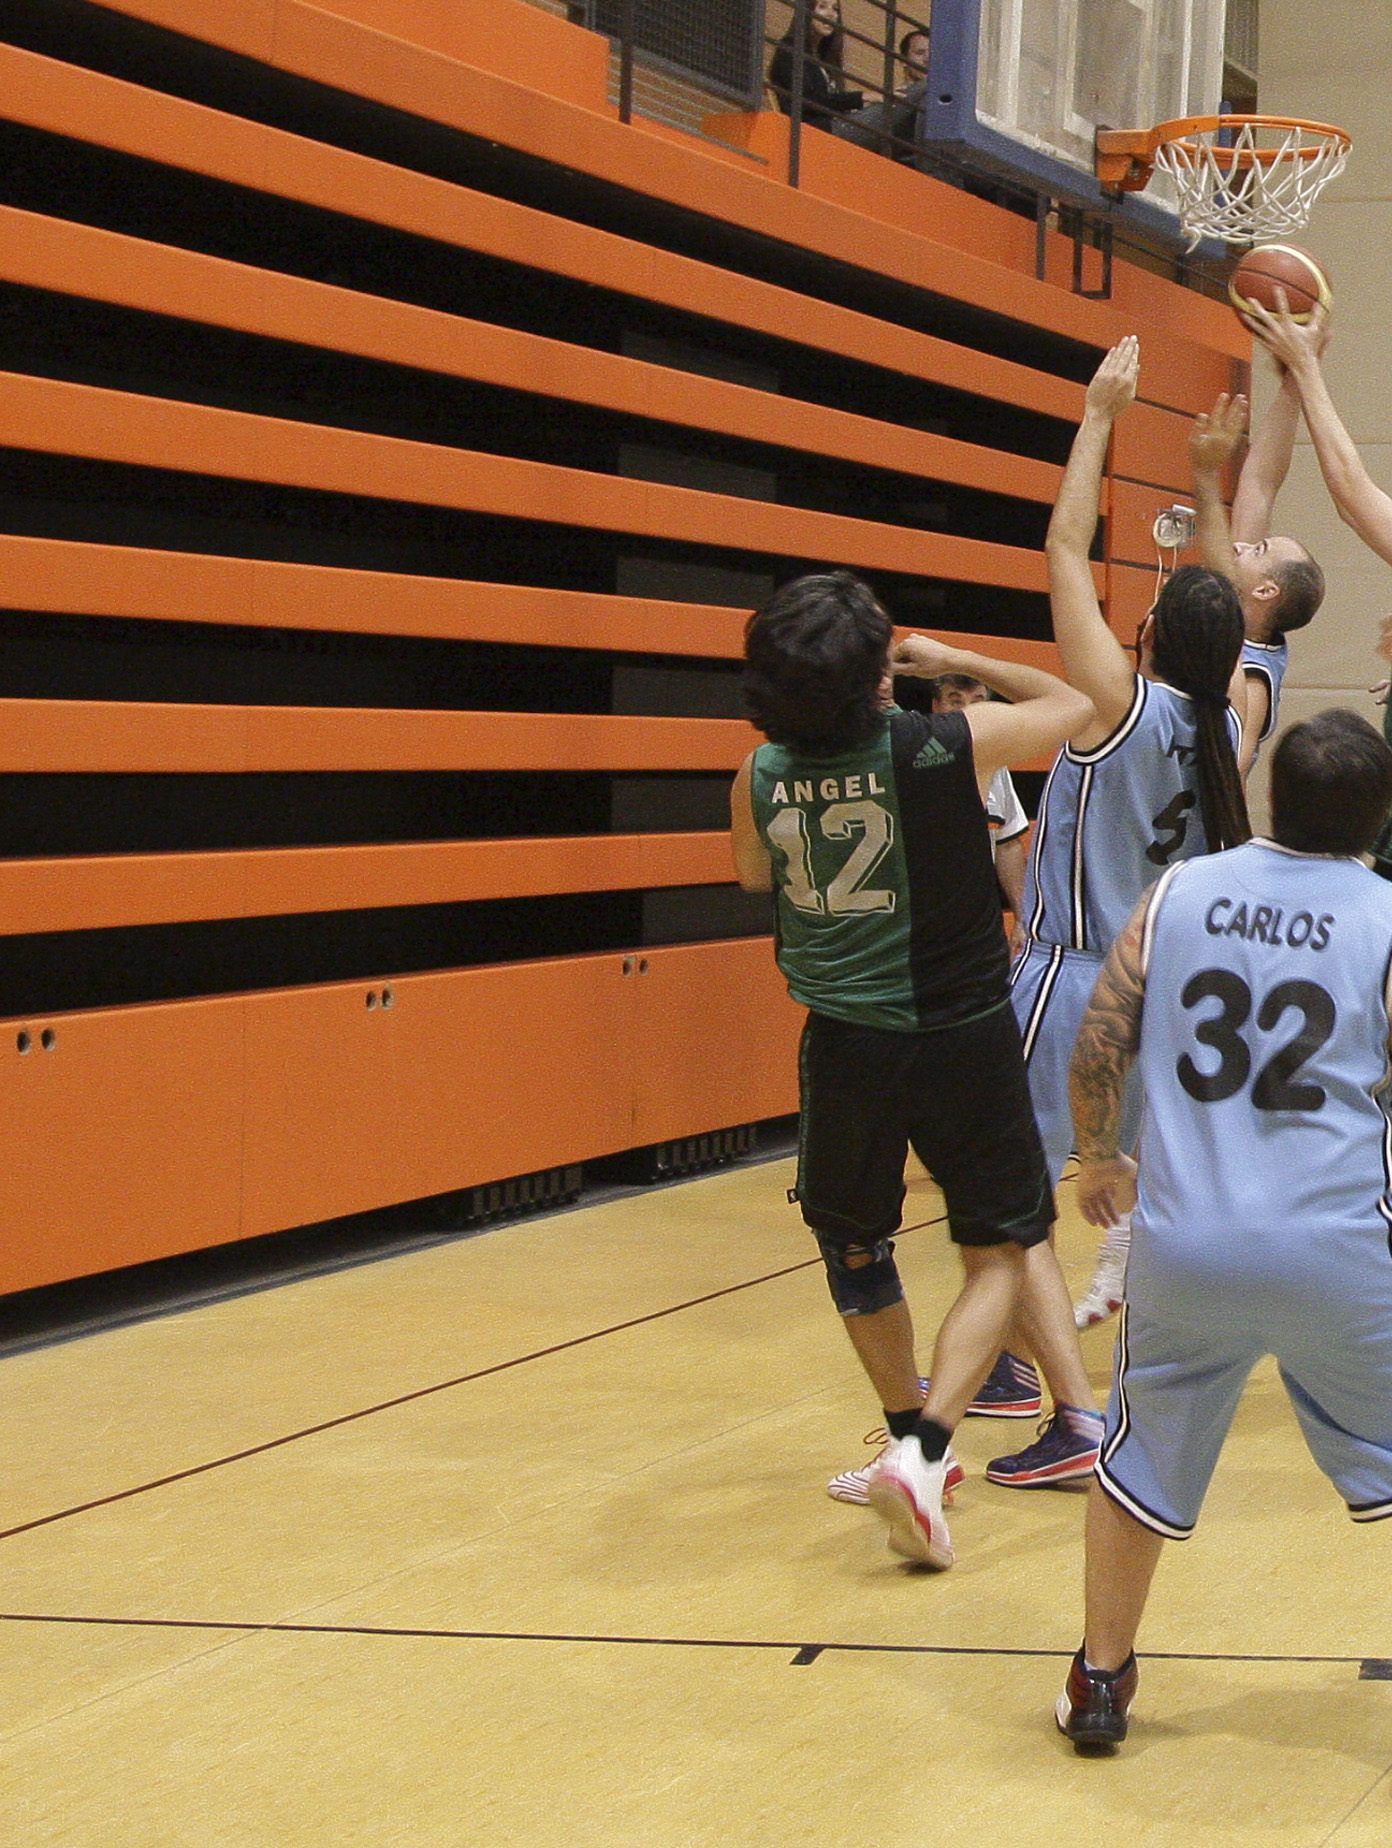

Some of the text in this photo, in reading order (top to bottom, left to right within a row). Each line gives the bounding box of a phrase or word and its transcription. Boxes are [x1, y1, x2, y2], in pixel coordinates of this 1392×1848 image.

[771, 772, 886, 804] ANGEL
[766, 799, 896, 917] 12
[1204, 896, 1337, 952] CARLOS
[1176, 966, 1337, 1111] 32
